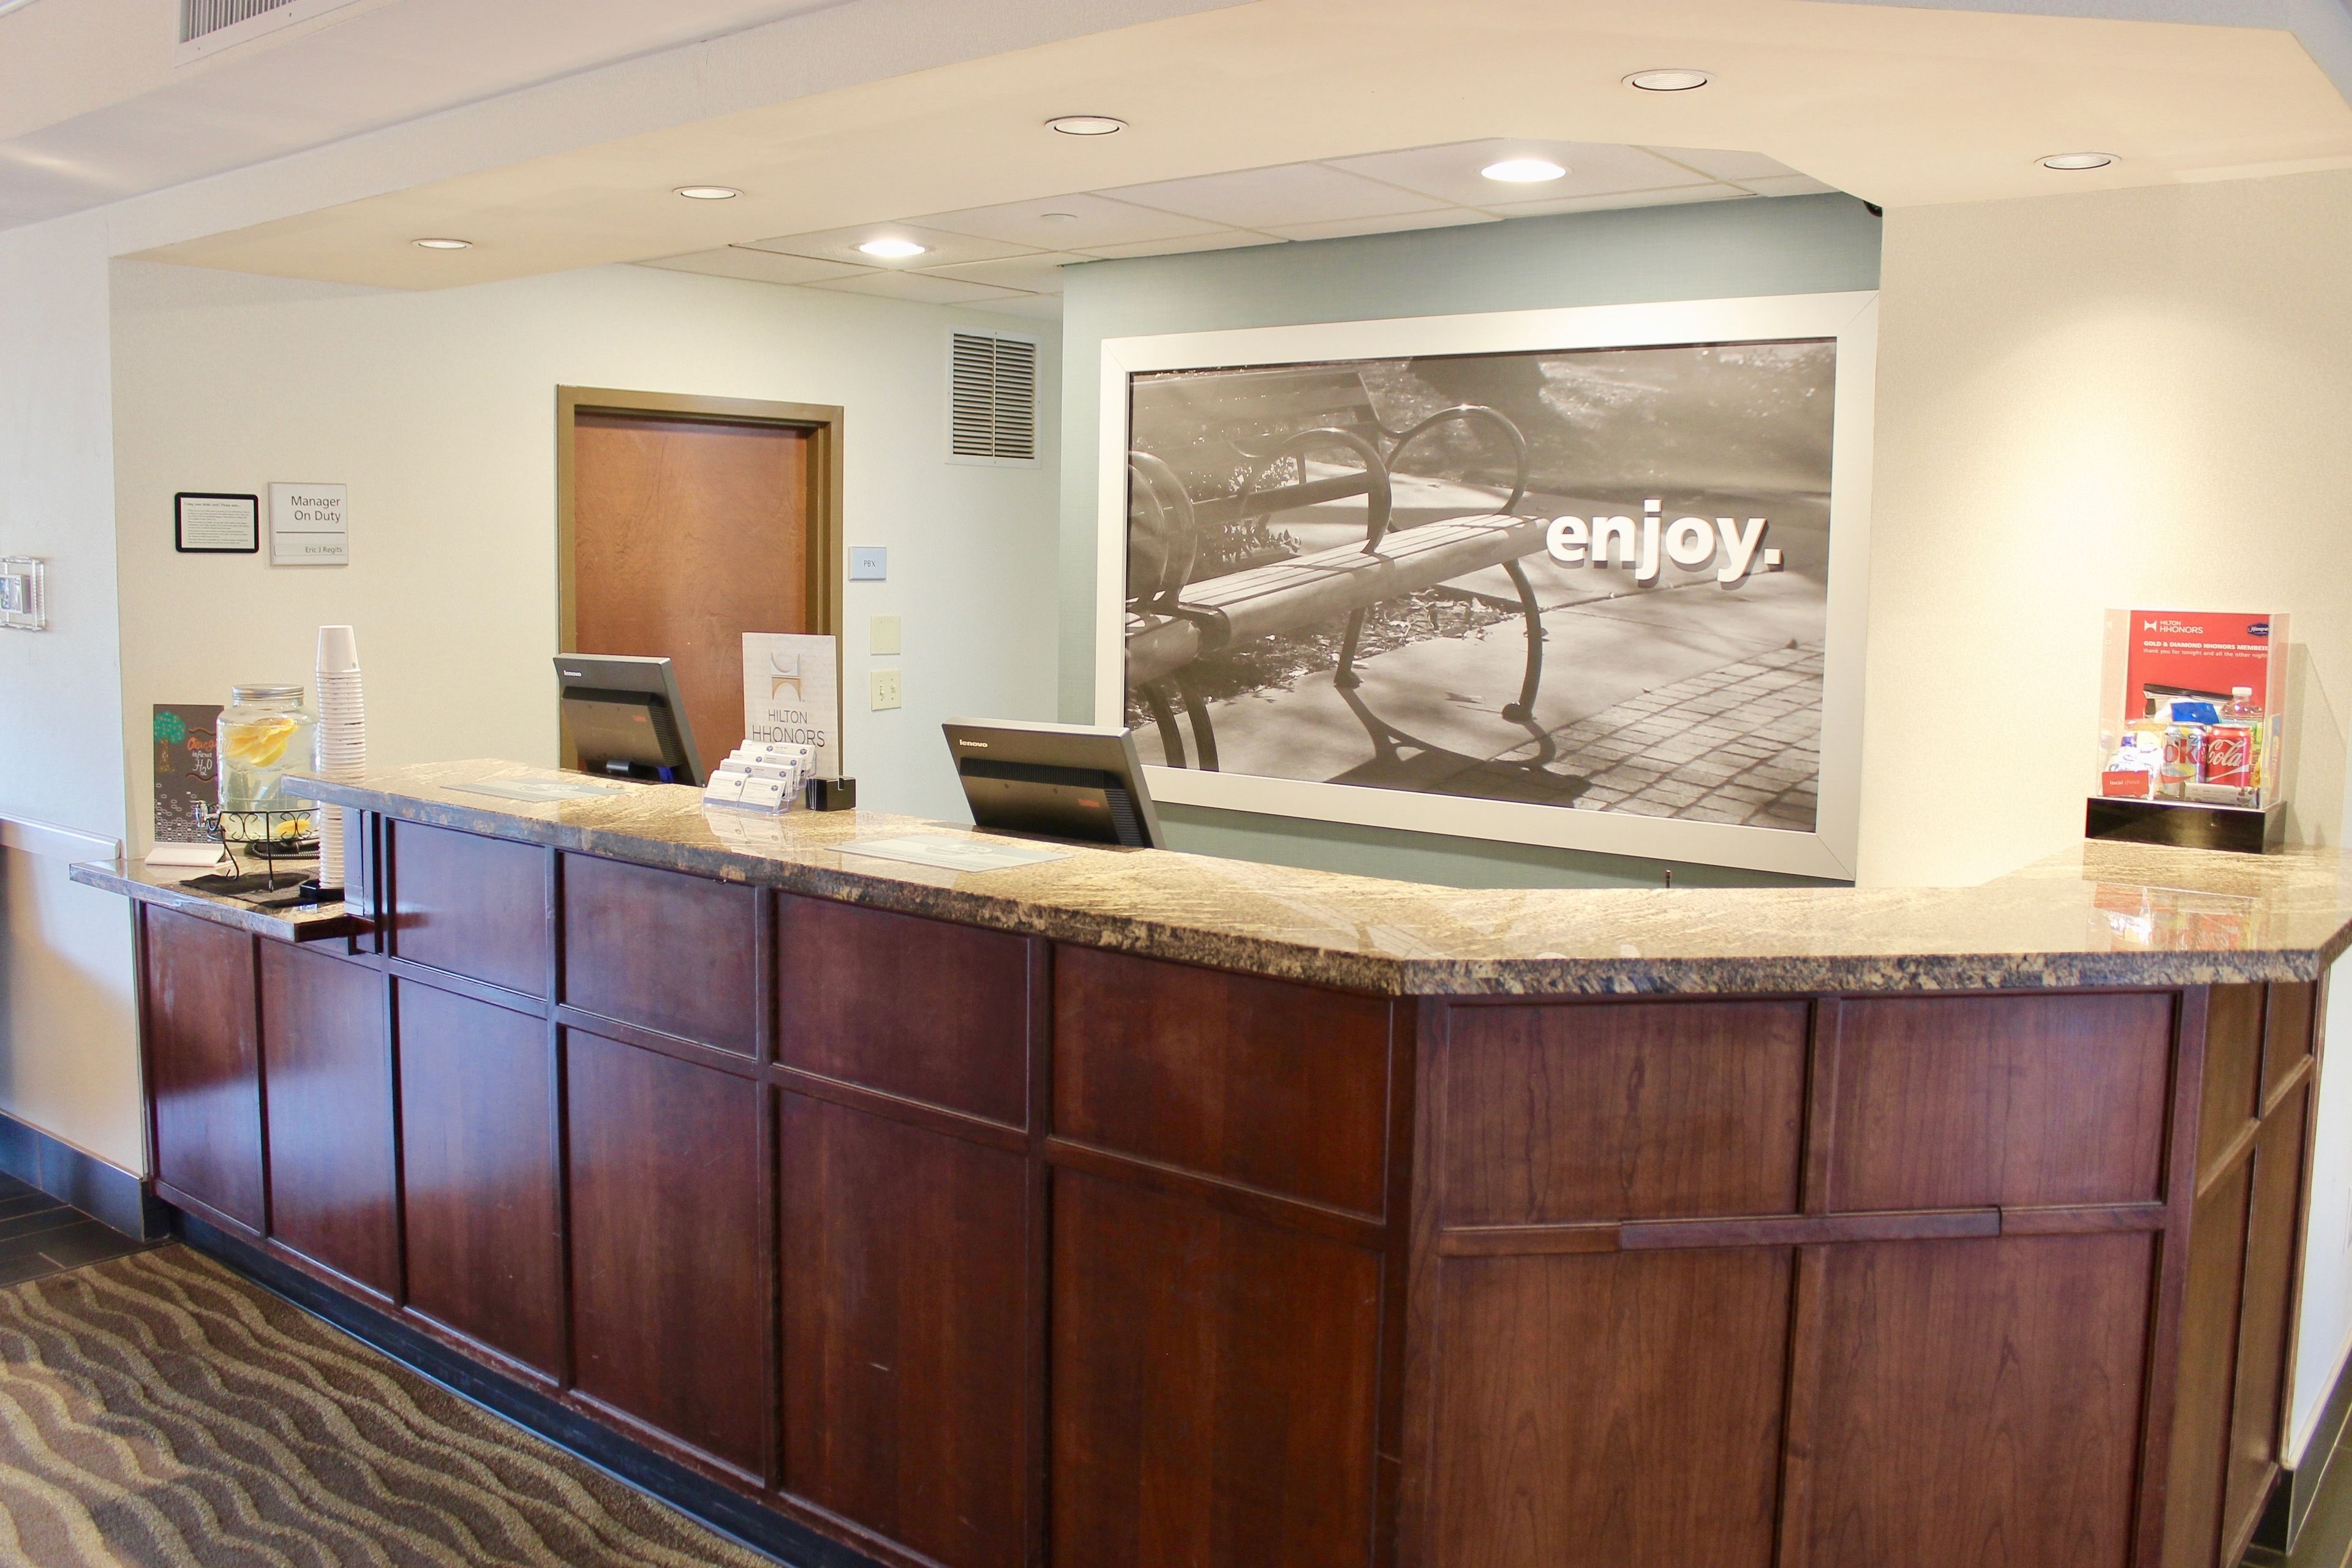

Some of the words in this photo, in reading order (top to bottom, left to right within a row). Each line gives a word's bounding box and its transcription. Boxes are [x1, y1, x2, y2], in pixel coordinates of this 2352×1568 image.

[291, 496, 341, 509] Manager
[294, 510, 311, 521] On
[315, 510, 341, 524] Duty
[1545, 498, 1782, 582] enjoy.
[2160, 625, 2204, 634] HHONORS
[768, 709, 808, 725] HILTON
[752, 725, 826, 747] HHONORS
[959, 739, 989, 748] lenovo
[187, 737, 216, 753] Orang
